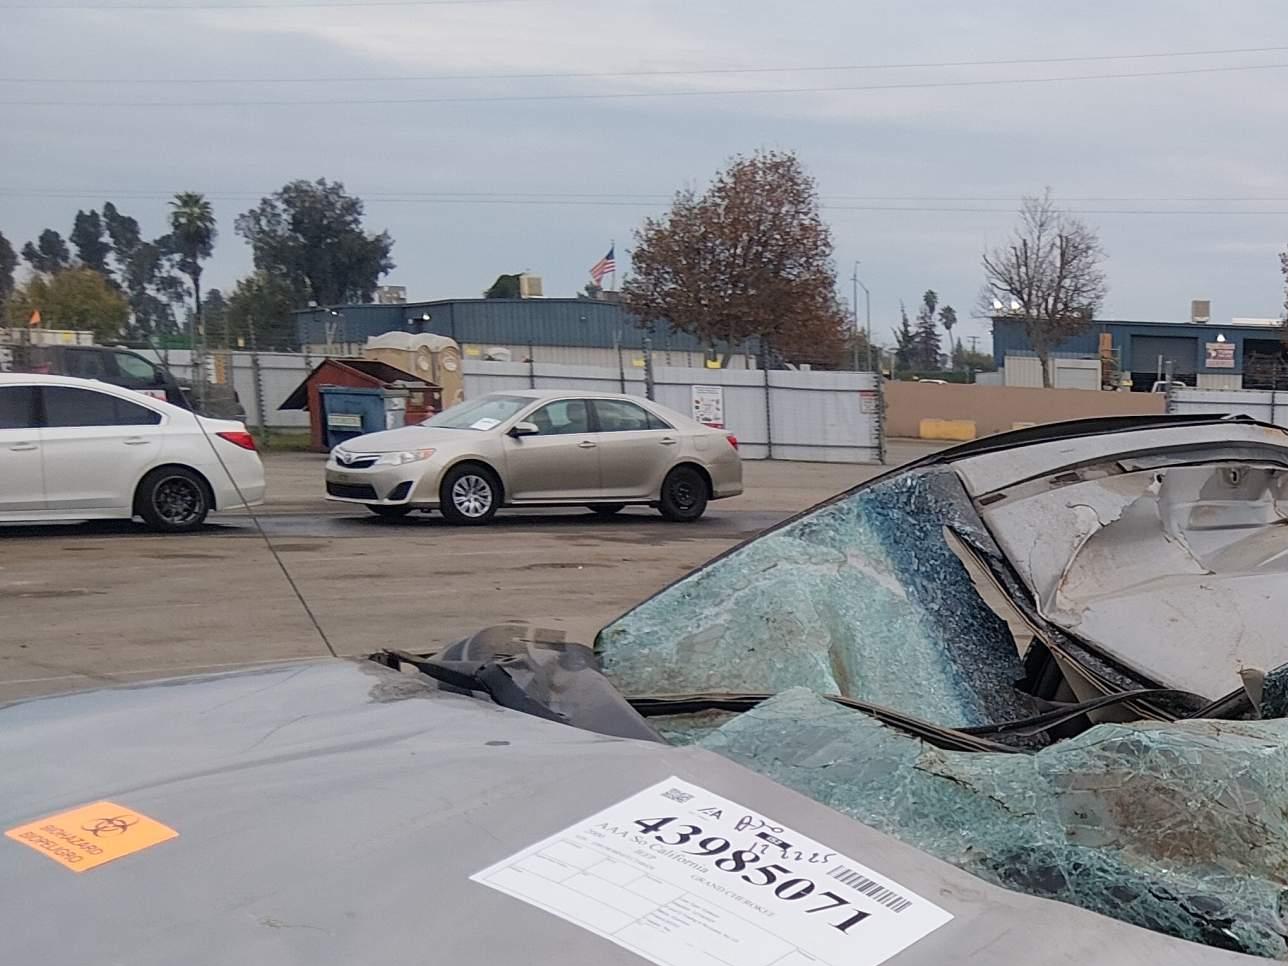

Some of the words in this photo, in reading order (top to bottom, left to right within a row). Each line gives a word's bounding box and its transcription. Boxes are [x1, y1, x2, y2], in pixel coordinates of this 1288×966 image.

[39, 824, 104, 856] BIOHAZARD
[595, 822, 629, 838] AAA
[649, 843, 709, 874] California
[633, 816, 873, 936] 43985071
